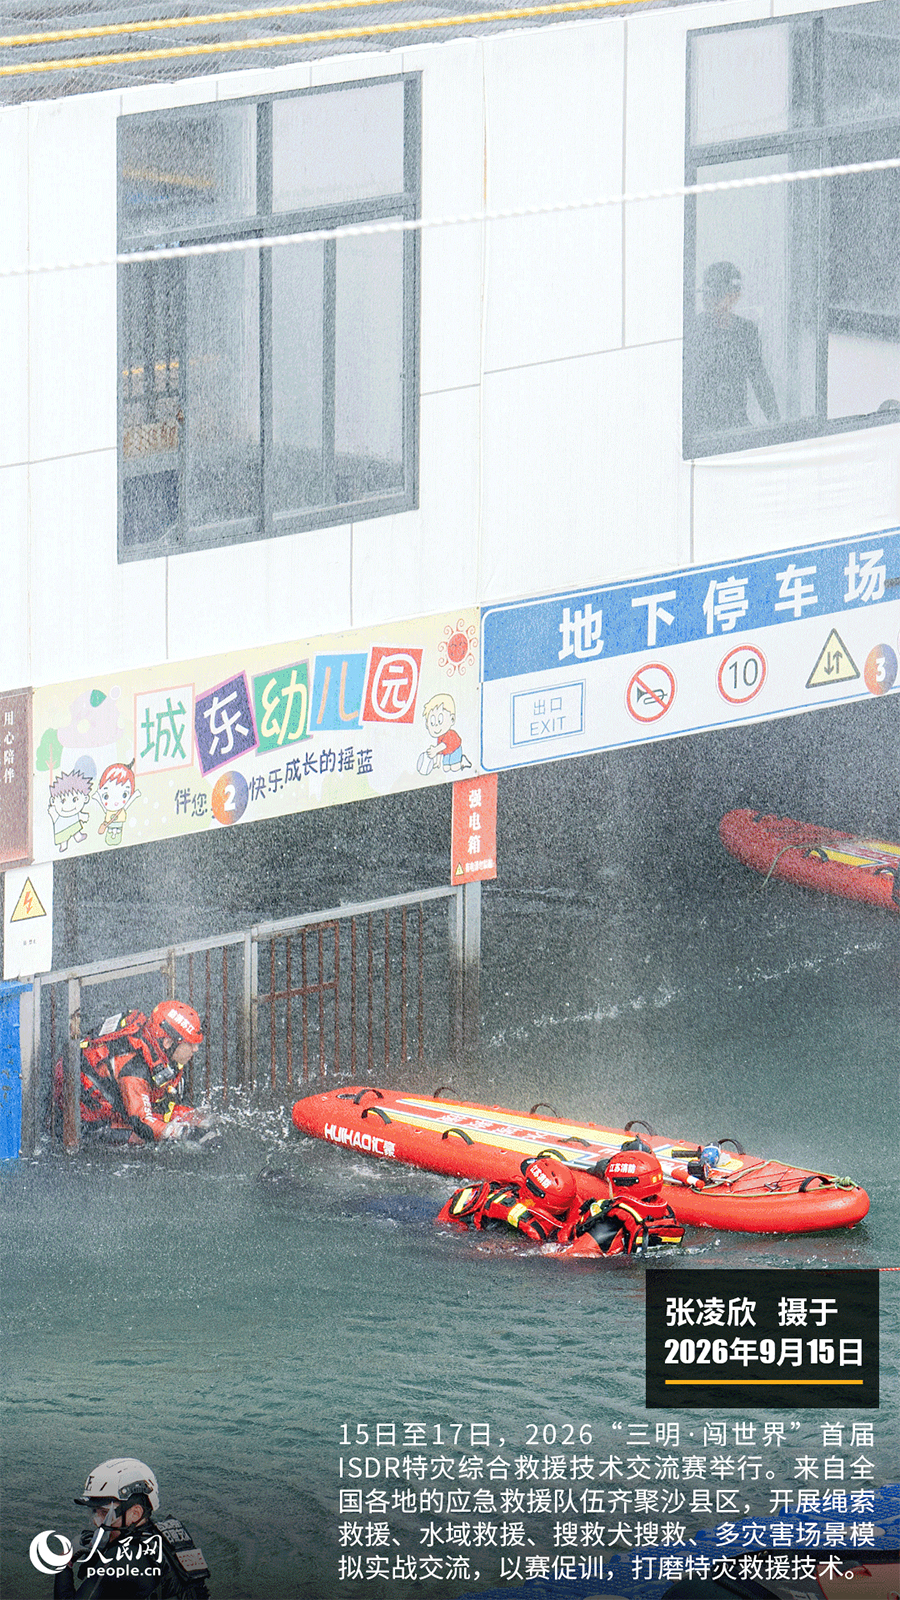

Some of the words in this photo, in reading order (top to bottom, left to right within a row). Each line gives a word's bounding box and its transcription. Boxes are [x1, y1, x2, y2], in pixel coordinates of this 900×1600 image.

[558, 548, 888, 662] 地下停车场
[728, 657, 759, 690] 10
[876, 657, 886, 682] 3
[139, 654, 420, 763] 城东幼儿园
[533, 696, 564, 717] 出口
[529, 717, 565, 737] EXIT
[3, 710, 15, 784] 用心陪伴
[224, 784, 237, 812] 2
[468, 788, 482, 855] 强电箱
